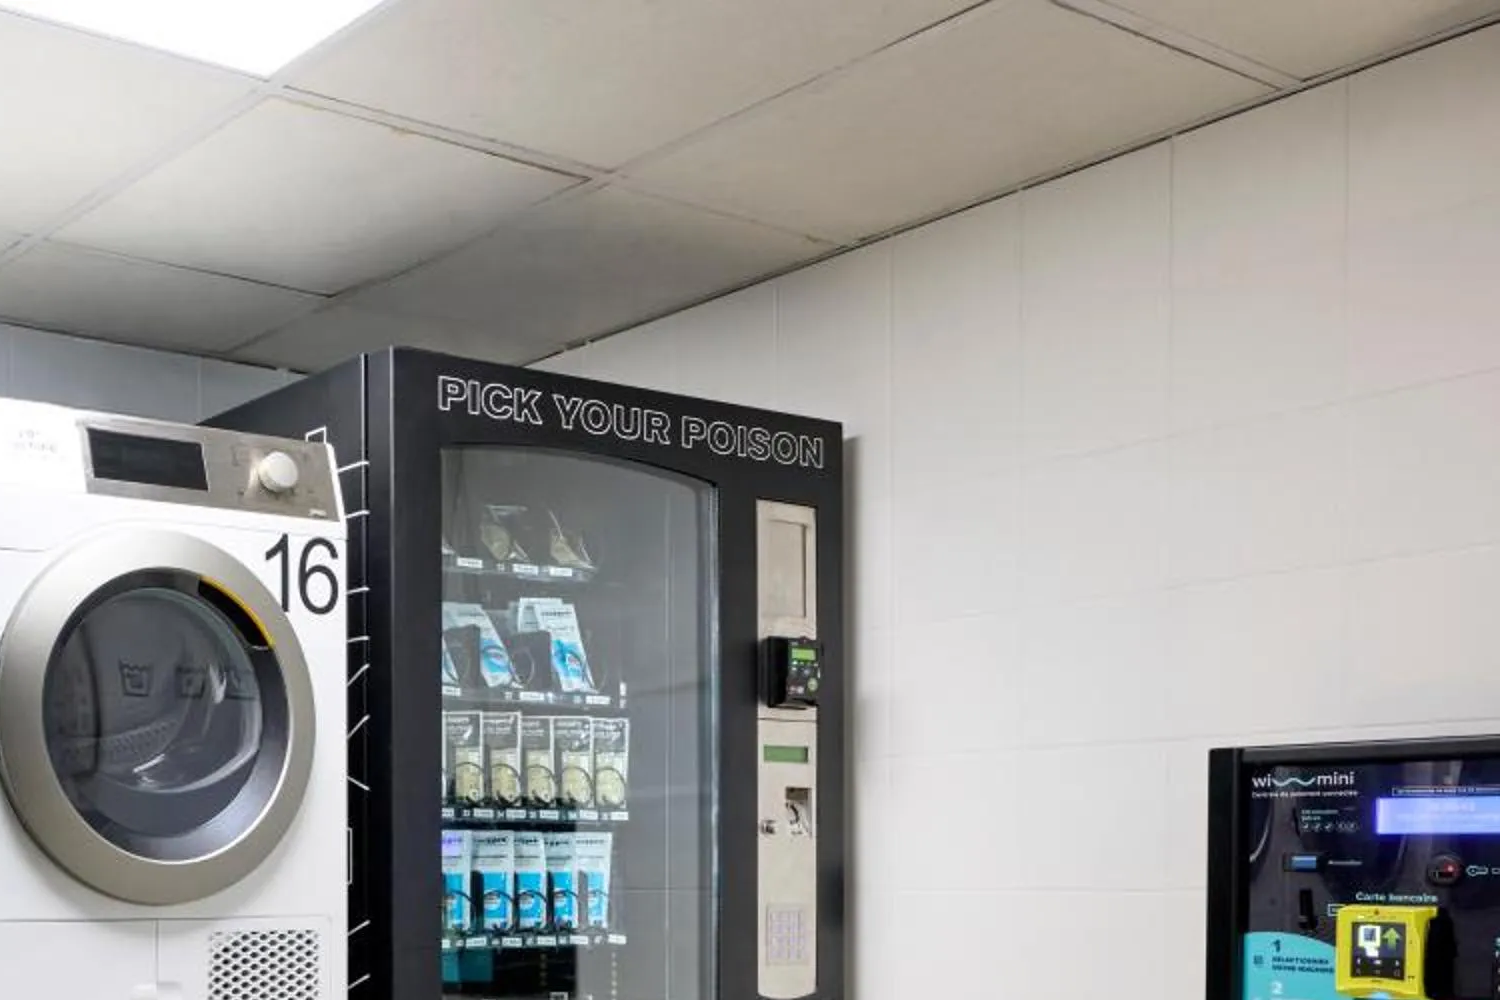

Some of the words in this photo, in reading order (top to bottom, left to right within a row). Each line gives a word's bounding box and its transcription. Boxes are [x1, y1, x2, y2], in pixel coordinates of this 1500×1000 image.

[437, 375, 543, 425] PICK
[552, 393, 671, 445] YOUR
[681, 416, 825, 469] POISON
[264, 533, 339, 614] 16
[1317, 771, 1355, 786] mini
[1273, 939, 1281, 952] 1
